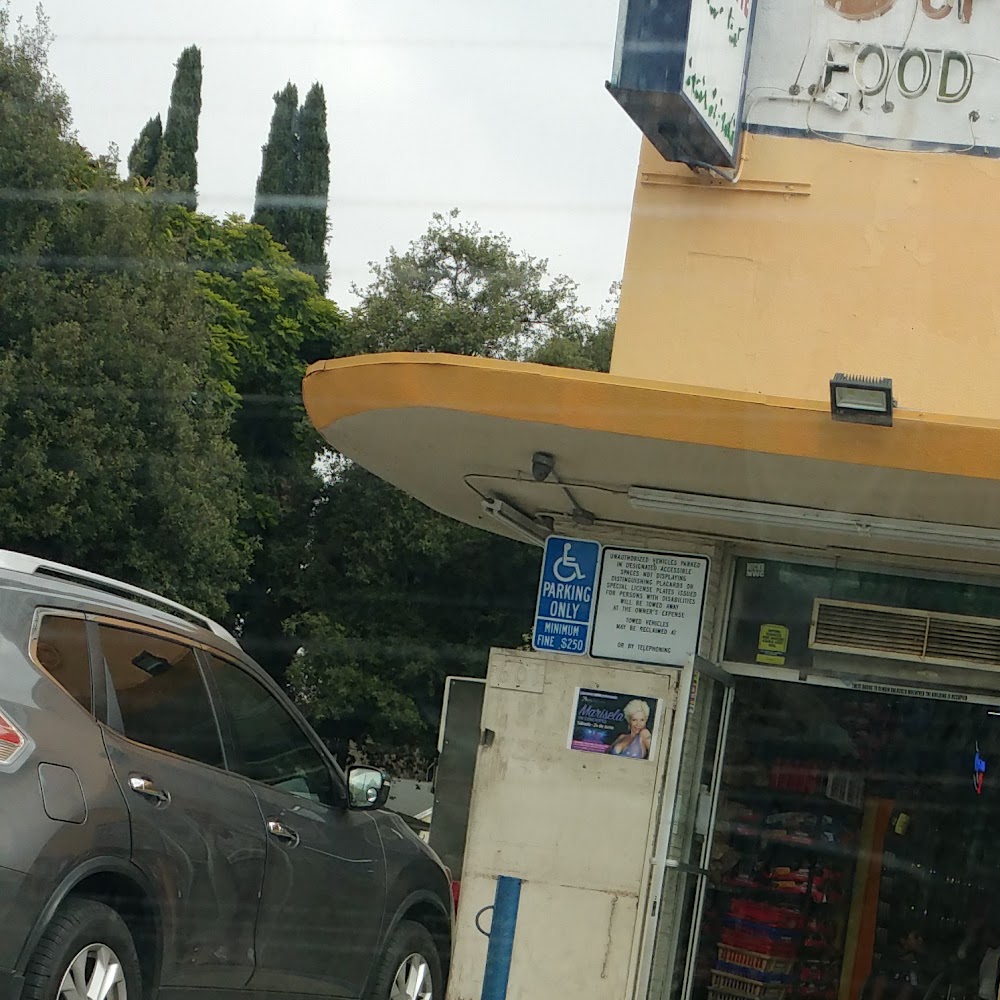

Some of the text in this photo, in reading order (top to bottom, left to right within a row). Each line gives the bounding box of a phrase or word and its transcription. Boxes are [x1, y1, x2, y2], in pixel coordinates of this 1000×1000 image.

[822, 39, 973, 103] FOOD
[610, 554, 701, 568] UNAUTHORIZED VEHICLES PARKED
[625, 562, 657, 571] DESIGNATED
[660, 566, 692, 575] ACCESSIBLE
[611, 575, 653, 585] DISTINGUISHING
[656, 580, 683, 589] PLACARDS
[656, 572, 686, 581] DISPLAYING
[542, 581, 591, 603] PARKING
[606, 582, 697, 598] SPECIAL LICENSE PLATES ISSUED
[619, 590, 643, 599] PERSONS
[662, 595, 696, 605] DISABILITIES
[620, 598, 632, 606] WILL
[646, 601, 663, 609] TOWED
[549, 600, 580, 620] ONLY
[661, 610, 685, 619] EXPENSE
[544, 621, 580, 637] MINIMUM
[625, 617, 669, 628] TOWED VEHICLES
[629, 624, 636, 632] BE
[639, 626, 667, 635] RECLAIMED
[536, 634, 584, 651] FINE $250
[637, 643, 671, 654] TELEPHONING
[579, 704, 625, 721] Marisela
